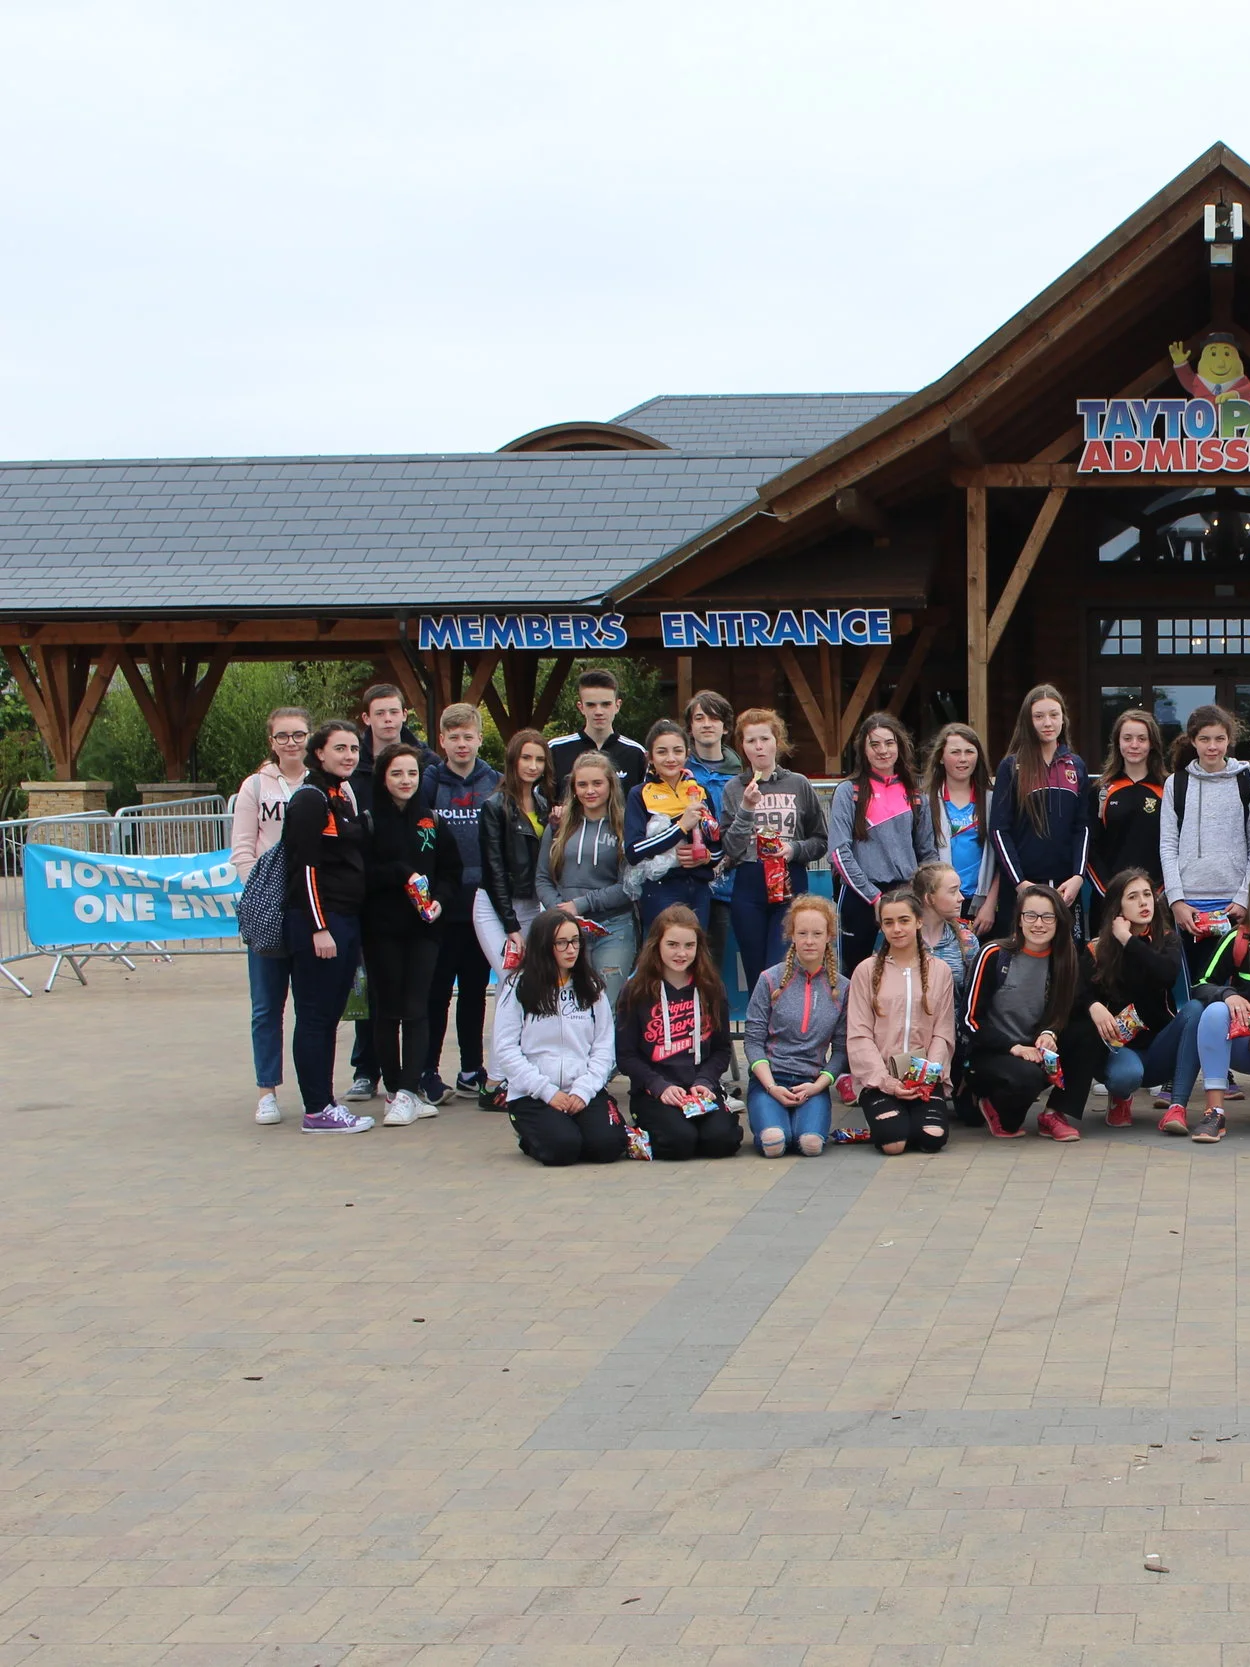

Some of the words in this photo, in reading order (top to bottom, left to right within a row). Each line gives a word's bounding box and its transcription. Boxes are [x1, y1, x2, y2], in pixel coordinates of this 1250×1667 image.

[1077, 399, 1217, 440] TAYTO
[419, 613, 627, 650] MEMBERS
[660, 609, 892, 647] ENTRANCE
[755, 794, 797, 809] RONX
[754, 811, 796, 834] 994
[74, 893, 155, 924] ONE
[167, 892, 241, 920] ENT
